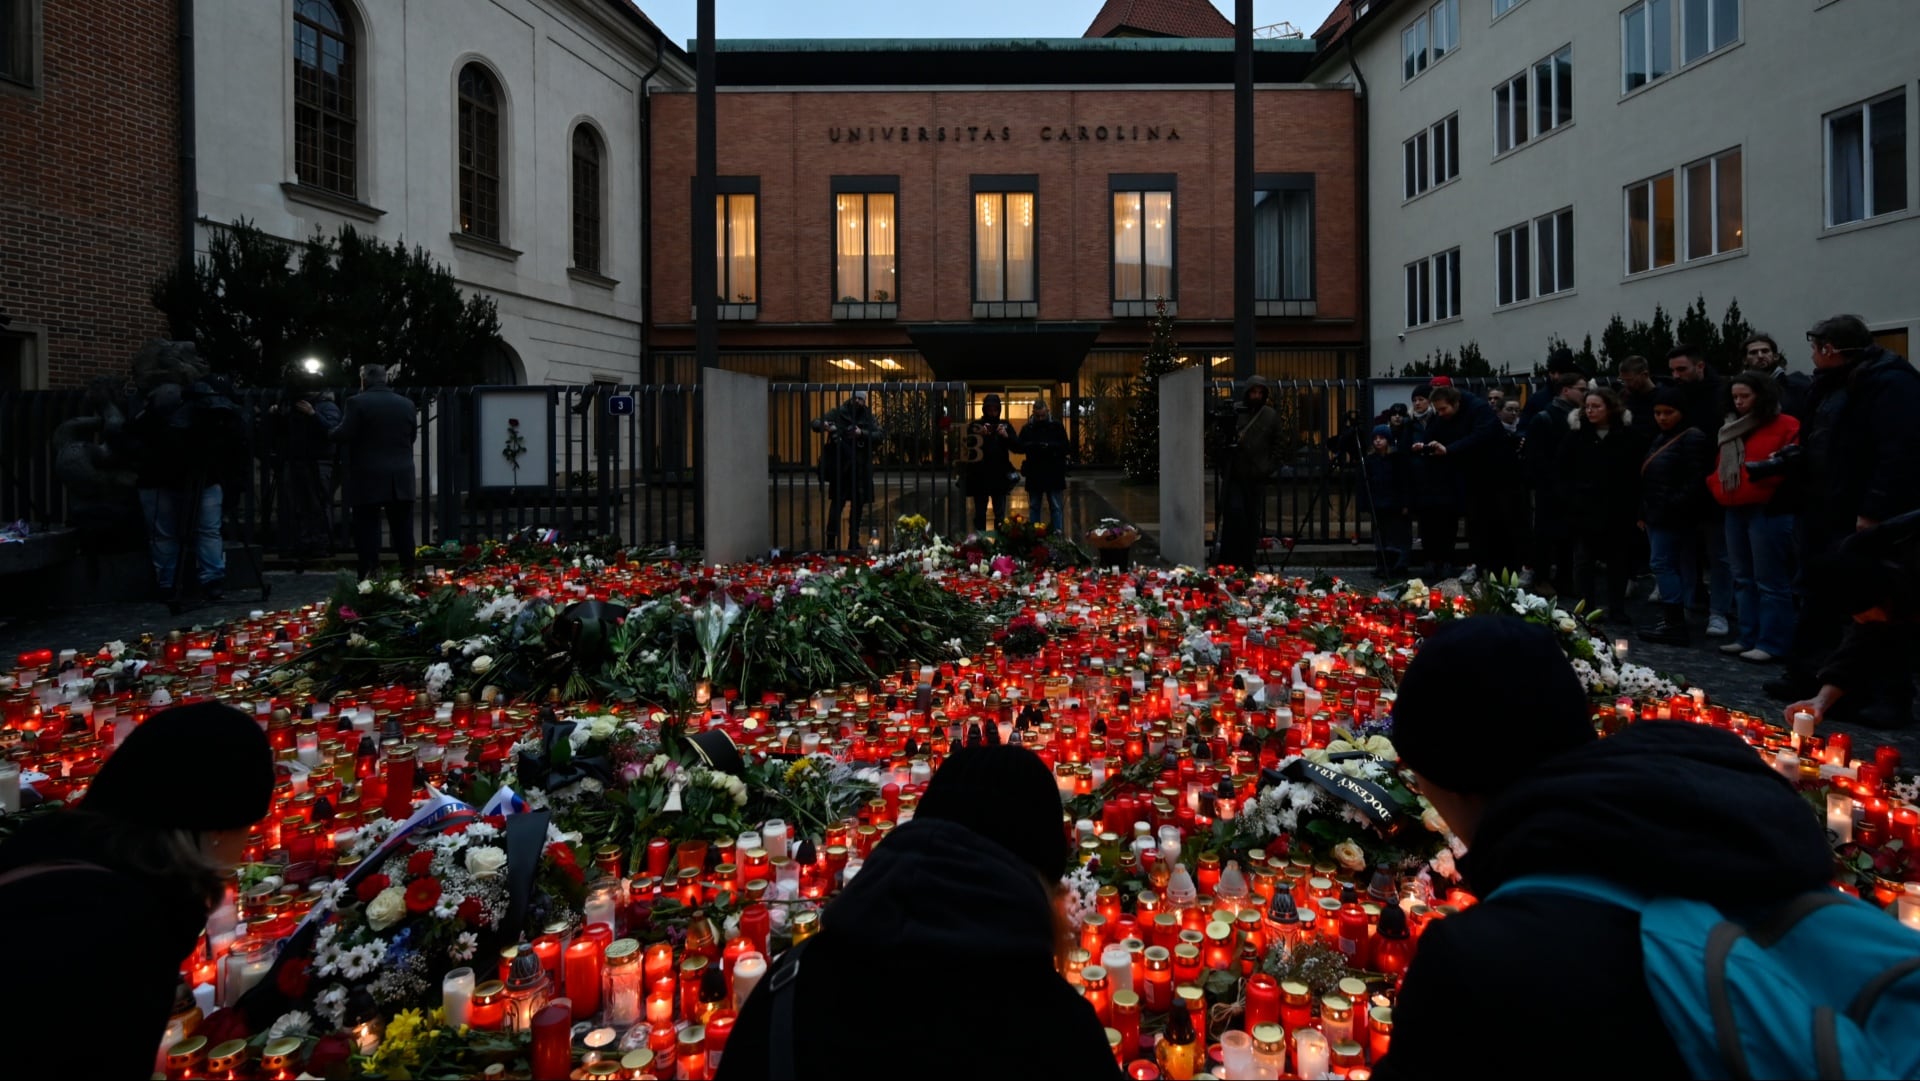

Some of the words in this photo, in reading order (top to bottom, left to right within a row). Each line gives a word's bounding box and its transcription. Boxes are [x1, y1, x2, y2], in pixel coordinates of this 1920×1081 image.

[829, 126, 1011, 142] UNIVERSITAS
[1040, 126, 1181, 141] CAROLINA
[617, 400, 625, 410] 3
